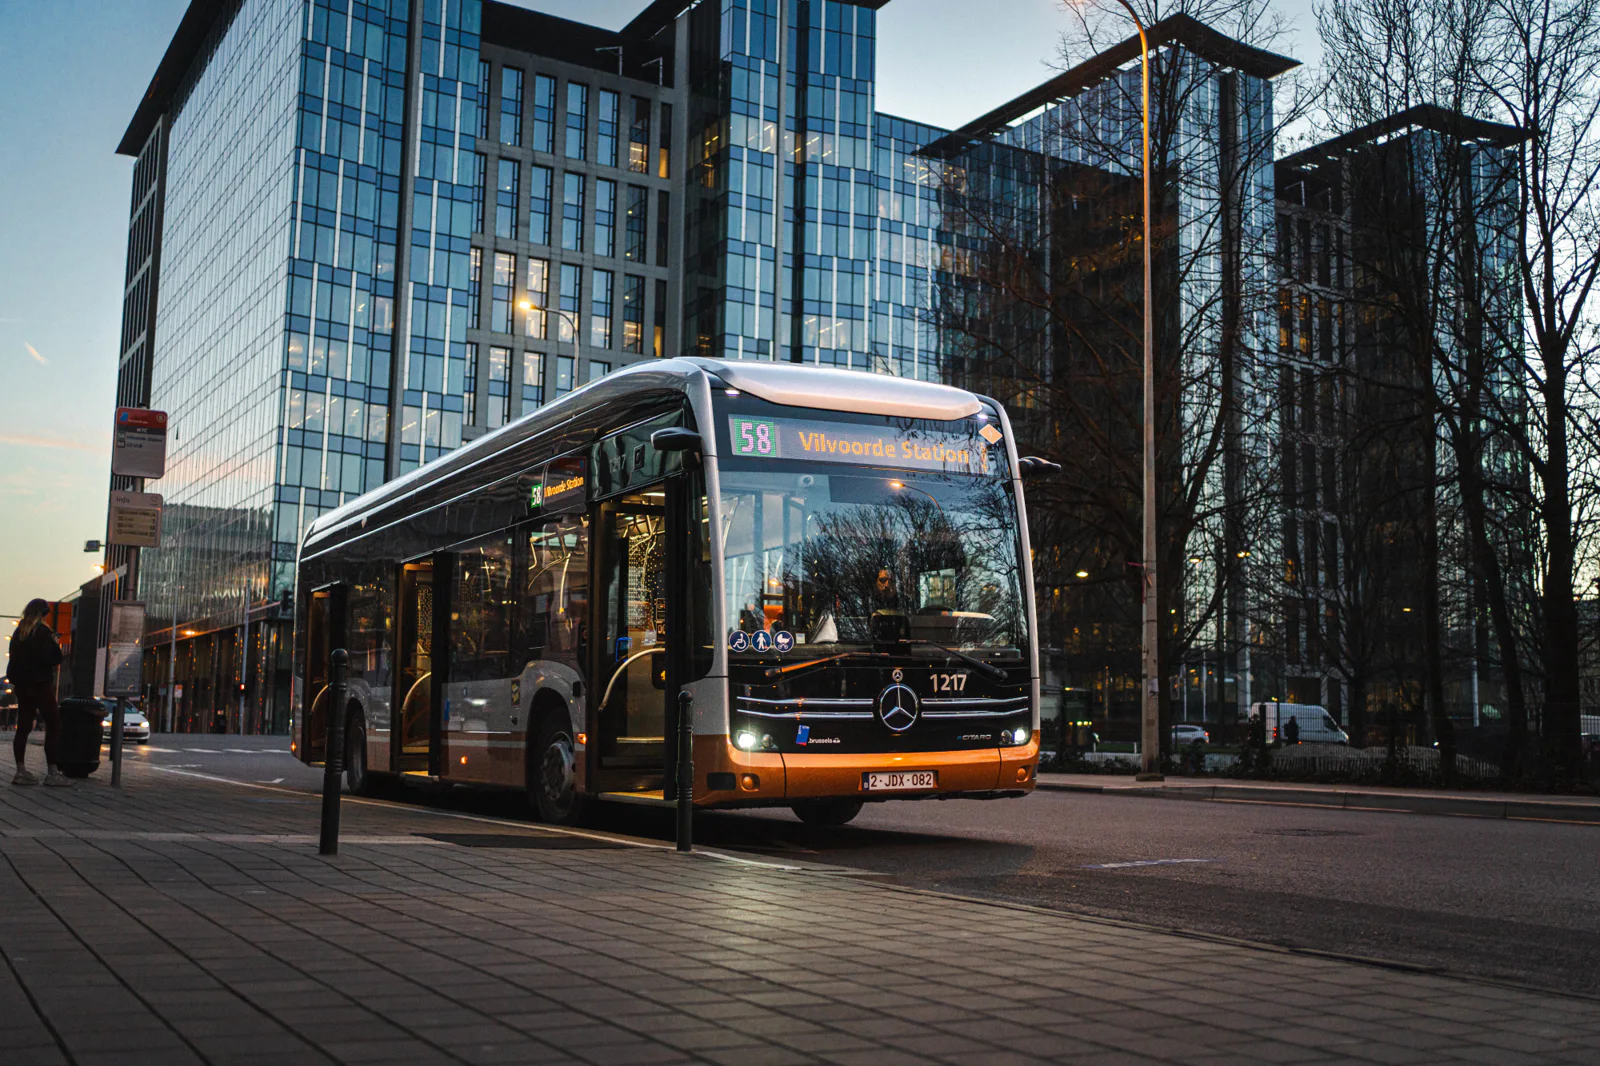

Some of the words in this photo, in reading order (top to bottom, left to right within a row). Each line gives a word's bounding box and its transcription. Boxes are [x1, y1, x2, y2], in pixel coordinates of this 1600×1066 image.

[741, 422, 771, 455] 58
[798, 431, 896, 458] Vilvoorde
[901, 440, 969, 465] Station
[609, 454, 626, 473] 1217
[532, 486, 541, 506] 58
[566, 476, 584, 491] Station
[930, 673, 967, 692] 1217
